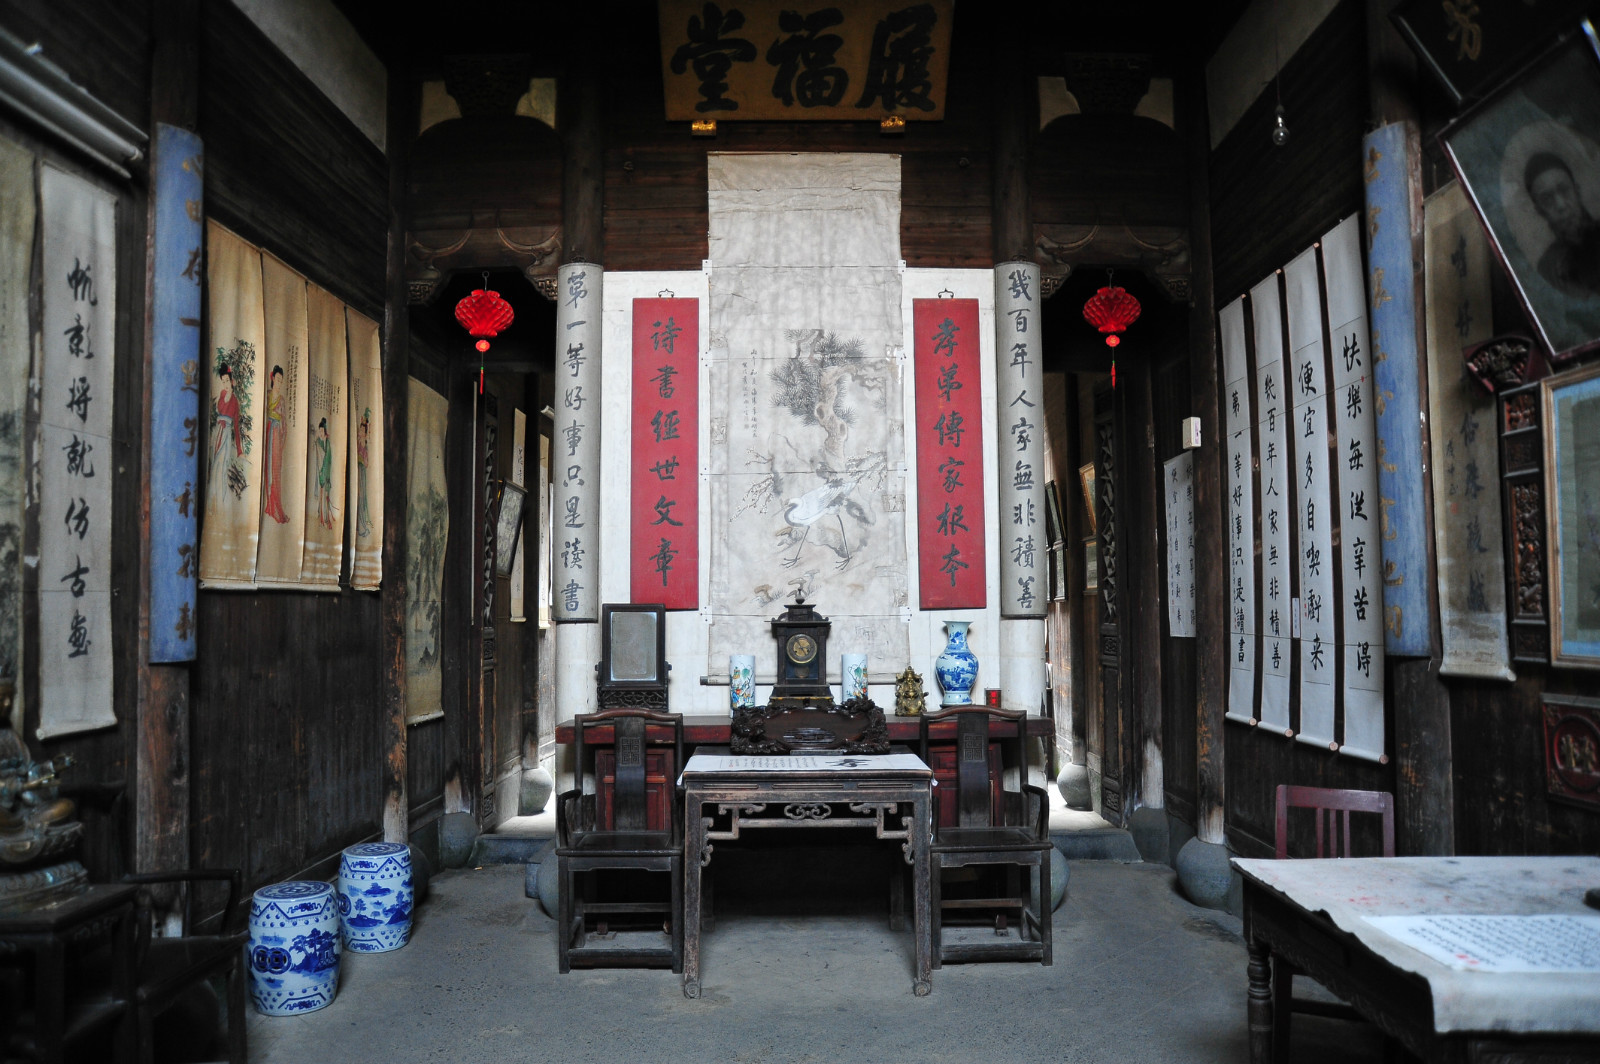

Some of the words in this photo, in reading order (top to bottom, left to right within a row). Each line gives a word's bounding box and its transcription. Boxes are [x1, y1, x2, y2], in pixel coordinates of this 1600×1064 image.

[649, 317, 683, 587] 詩書經世文章
